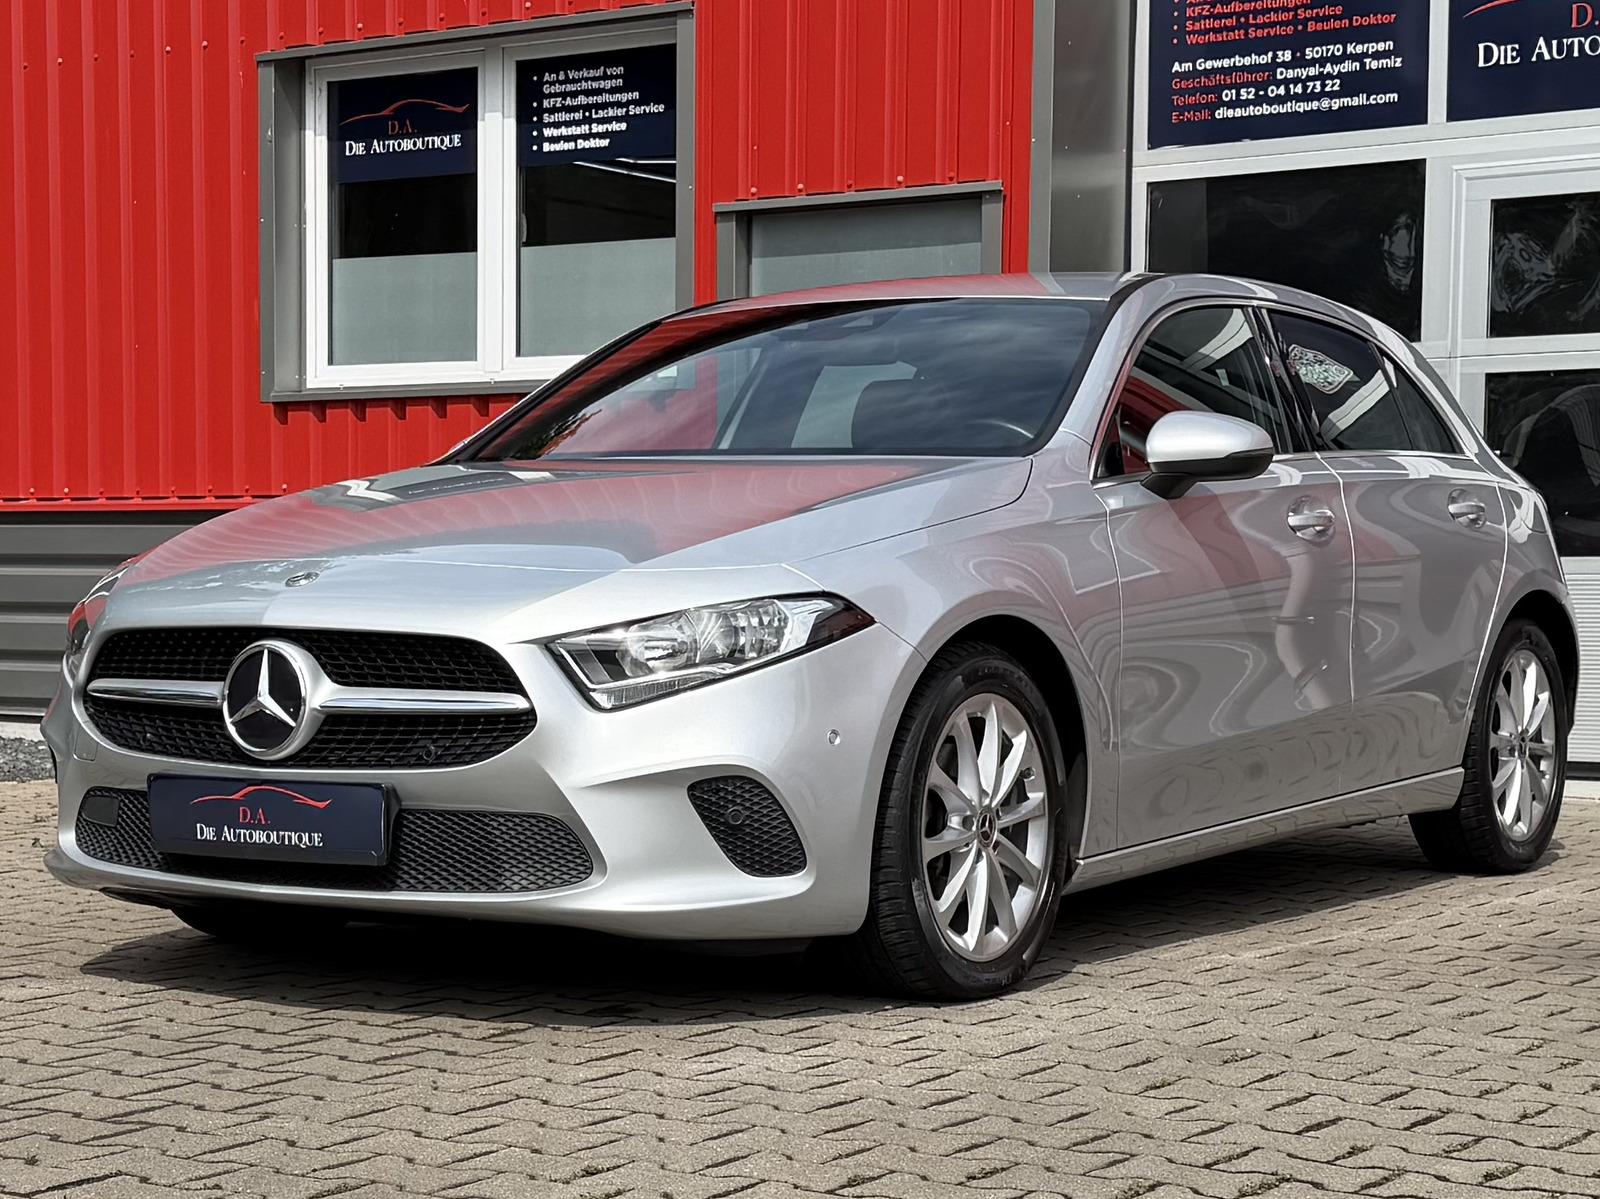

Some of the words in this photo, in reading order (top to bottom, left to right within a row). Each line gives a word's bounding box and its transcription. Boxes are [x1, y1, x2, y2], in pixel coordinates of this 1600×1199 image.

[1185, 16, 1236, 31] Sattlerei
[1249, 10, 1295, 24] Lackier
[1297, 5, 1343, 19] Service
[1185, 29, 1245, 45] Werkstatt
[1248, 25, 1294, 38] Service
[1307, 18, 1349, 32] Beulen
[1352, 13, 1397, 27] Doktor
[1171, 61, 1193, 73] Am
[1196, 51, 1274, 70] Gewerbehof
[1275, 49, 1292, 63] 38
[1305, 44, 1343, 60] 50170
[1346, 40, 1394, 55] Kerpen
[543, 72, 557, 82] An
[558, 71, 565, 80] &
[568, 66, 604, 79] Verkauf
[607, 66, 624, 75] von
[1171, 71, 1273, 90] Geschäftsführer:
[1276, 59, 1360, 79] Danyal-Aydin
[1363, 55, 1403, 70] Temiz
[543, 78, 623, 94] Gebrauchtwagen
[1171, 92, 1218, 106] Telefon:
[1222, 89, 1236, 102] 01
[1240, 87, 1256, 100] 52
[1267, 84, 1286, 97] 04
[1289, 82, 1303, 95] 14
[1306, 80, 1321, 94] 73
[1324, 78, 1341, 92] 22
[543, 90, 639, 108] KFZ-Aufbereitungen
[1171, 109, 1211, 123] E-Mail:
[1214, 92, 1399, 119] dieautoboutique@gmail.com
[543, 110, 583, 123] Sattlerei
[591, 106, 626, 119] Lackier
[628, 102, 665, 115] Service
[388, 119, 418, 135] D.A.
[543, 125, 590, 137] Werkstatt
[591, 121, 627, 133] Service
[543, 139, 575, 152] Beulen
[577, 137, 610, 149] Doktor
[238, 806, 271, 825] D.A.
